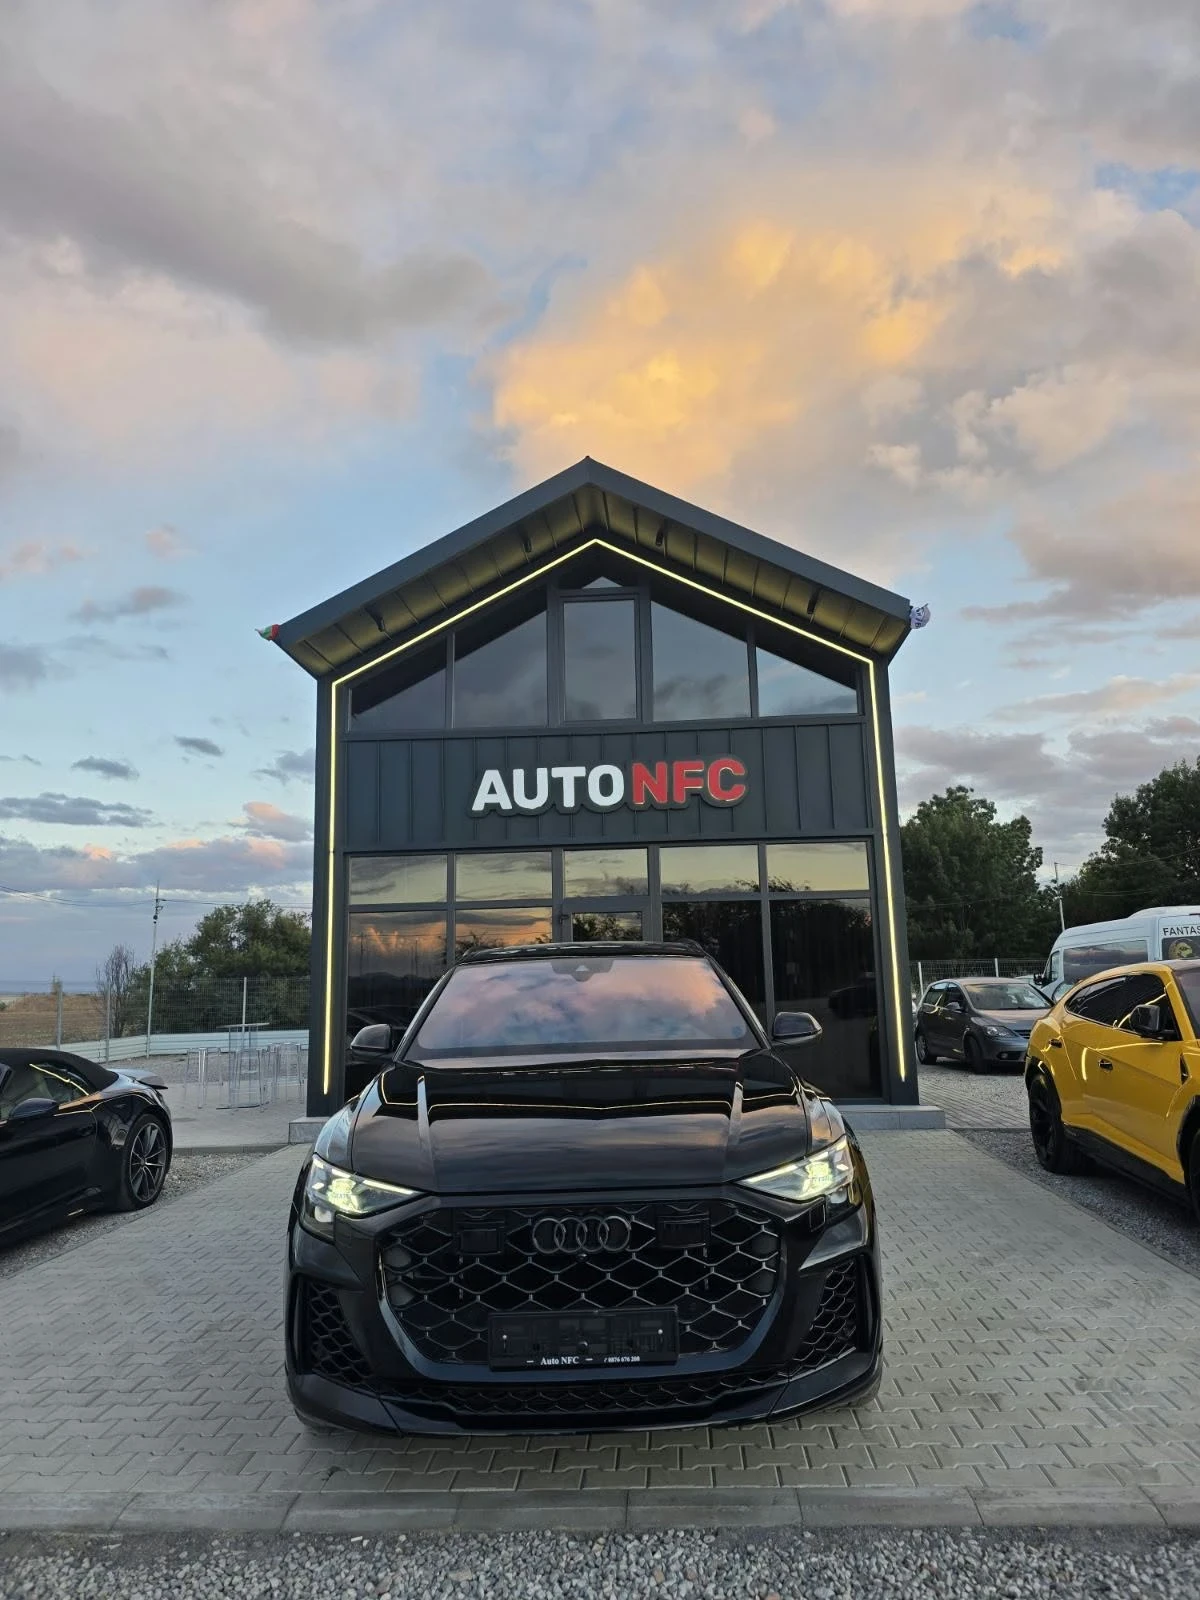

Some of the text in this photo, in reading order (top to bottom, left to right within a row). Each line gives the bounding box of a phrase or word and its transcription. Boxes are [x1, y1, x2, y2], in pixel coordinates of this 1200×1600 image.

[472, 758, 746, 811] AUTO NFC
[540, 1356, 580, 1366] Auto NFC
